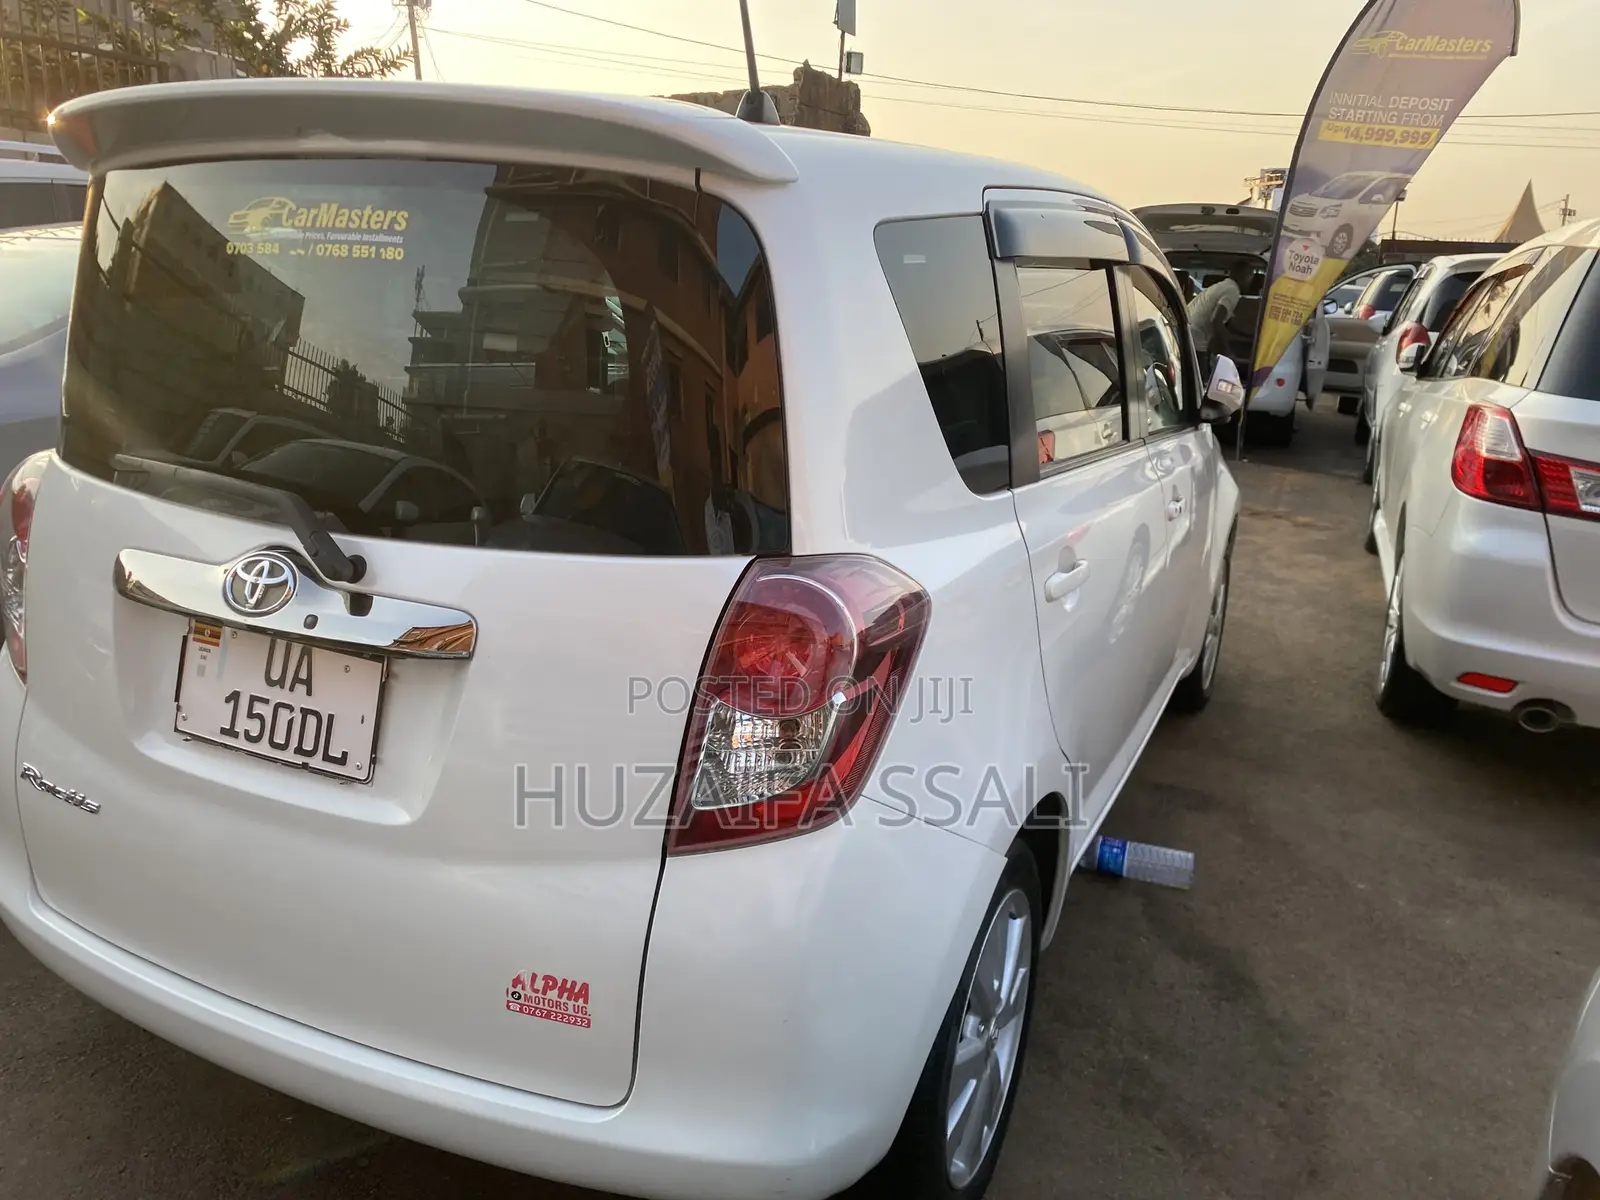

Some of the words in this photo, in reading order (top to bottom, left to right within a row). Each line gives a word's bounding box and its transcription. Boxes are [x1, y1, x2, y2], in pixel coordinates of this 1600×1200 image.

[1395, 33, 1493, 53] CarMasters
[1329, 92, 1384, 108] INNITIAL
[1388, 98, 1454, 111] DEPOSIT
[1328, 107, 1397, 124] STARTING
[1401, 112, 1445, 128] FROM
[281, 203, 409, 231] CarMasters
[316, 244, 348, 257] 0768
[352, 245, 376, 259] 551
[380, 247, 404, 260] 180
[1289, 250, 1320, 265] Toyota
[1289, 261, 1313, 275] Noah
[264, 637, 313, 697] UA
[219, 689, 349, 767] 150DL
[511, 969, 589, 1005] ALPHA
[523, 993, 569, 1012] MOTORS
[522, 1005, 548, 1018] 0767
[550, 1011, 588, 1027] 222932
